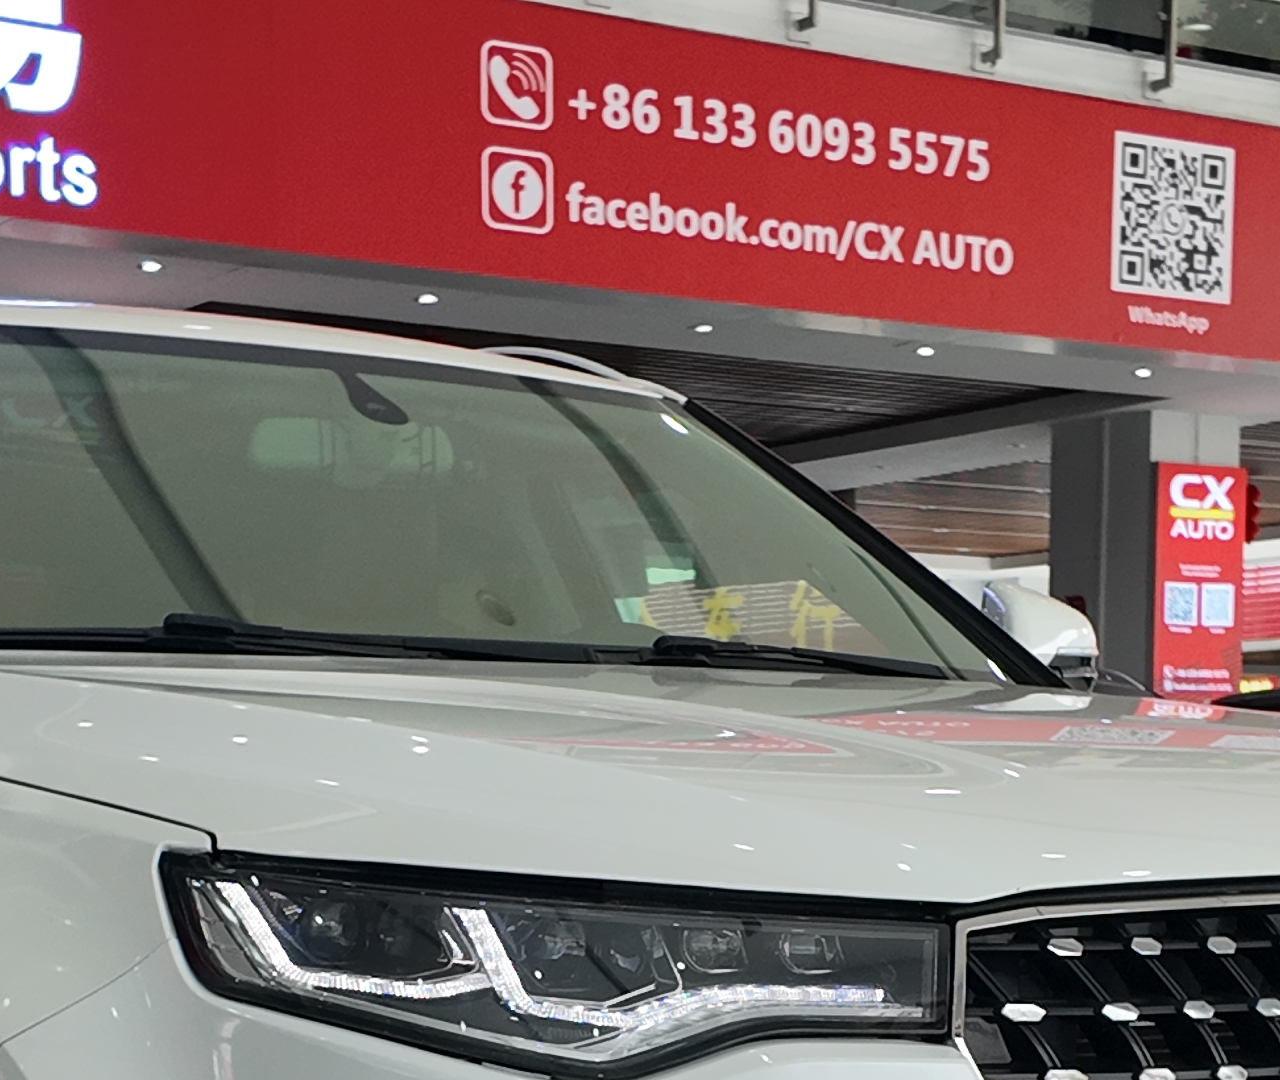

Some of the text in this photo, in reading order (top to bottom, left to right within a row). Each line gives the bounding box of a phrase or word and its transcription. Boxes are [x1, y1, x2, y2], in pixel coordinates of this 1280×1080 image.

[568, 83, 991, 182] +86 133 6093 5575
[565, 181, 1014, 276] facebook.com/CX AUTO
[1127, 304, 1210, 335] WhatsApp
[1169, 473, 1236, 511] CX
[1170, 519, 1235, 541] AUTO
